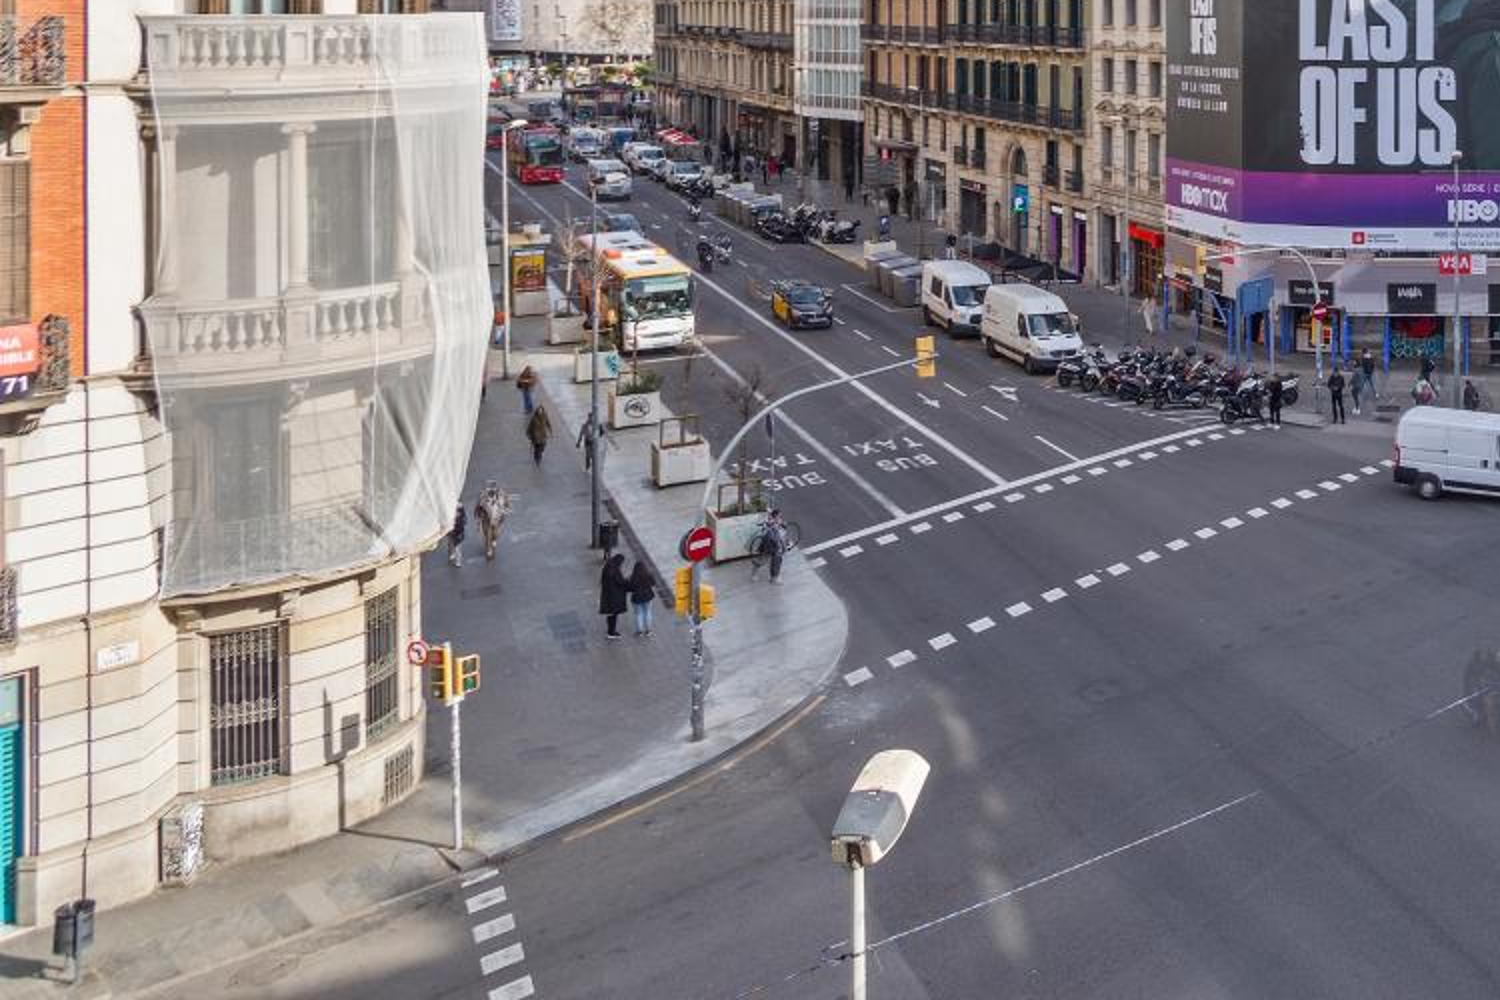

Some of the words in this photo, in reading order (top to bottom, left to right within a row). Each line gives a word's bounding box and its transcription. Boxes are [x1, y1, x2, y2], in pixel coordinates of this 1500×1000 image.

[1299, 66, 1368, 165] OF
[1376, 66, 1457, 165] US
[3, 374, 29, 395] 71
[875, 452, 939, 473] BUS
